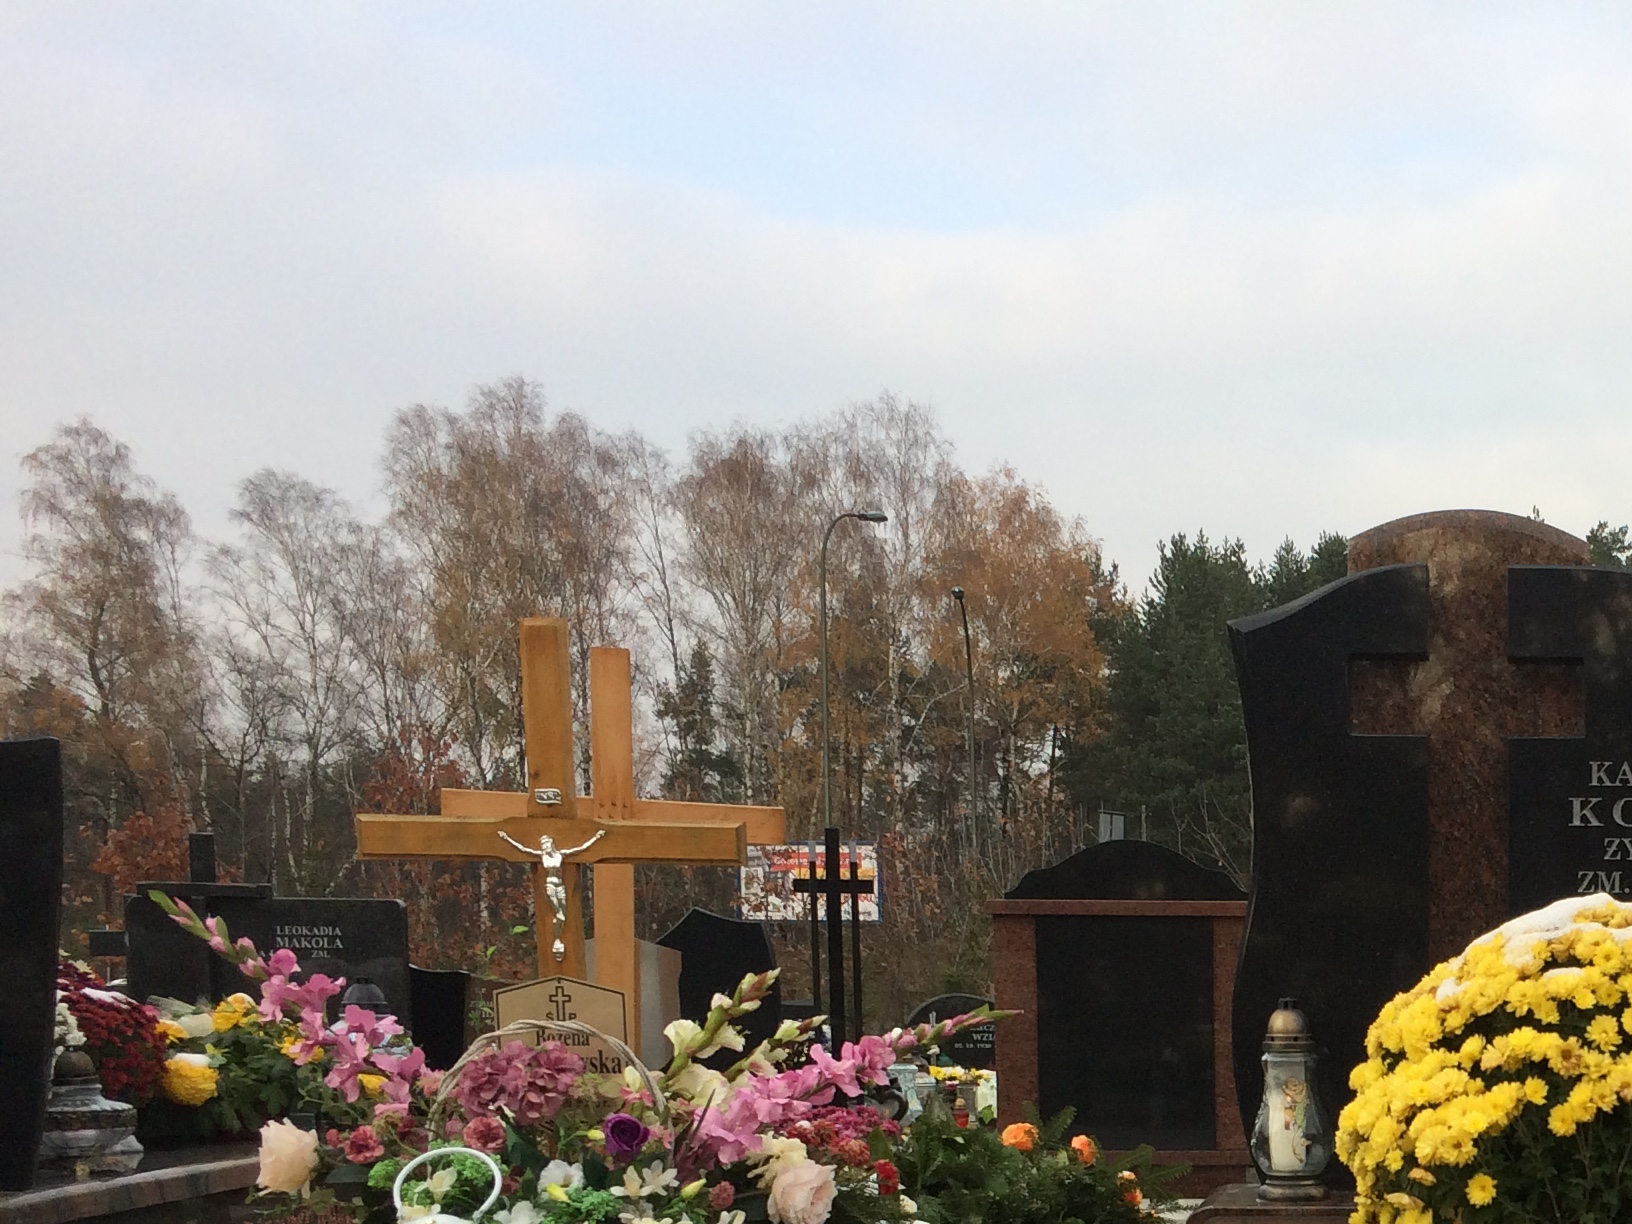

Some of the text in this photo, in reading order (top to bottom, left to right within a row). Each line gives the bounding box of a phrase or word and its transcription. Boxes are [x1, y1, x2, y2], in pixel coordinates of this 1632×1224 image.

[1577, 870, 1630, 894] ZM.
[276, 926, 342, 935] LEOKADIA
[275, 937, 344, 948] MAKOLA
